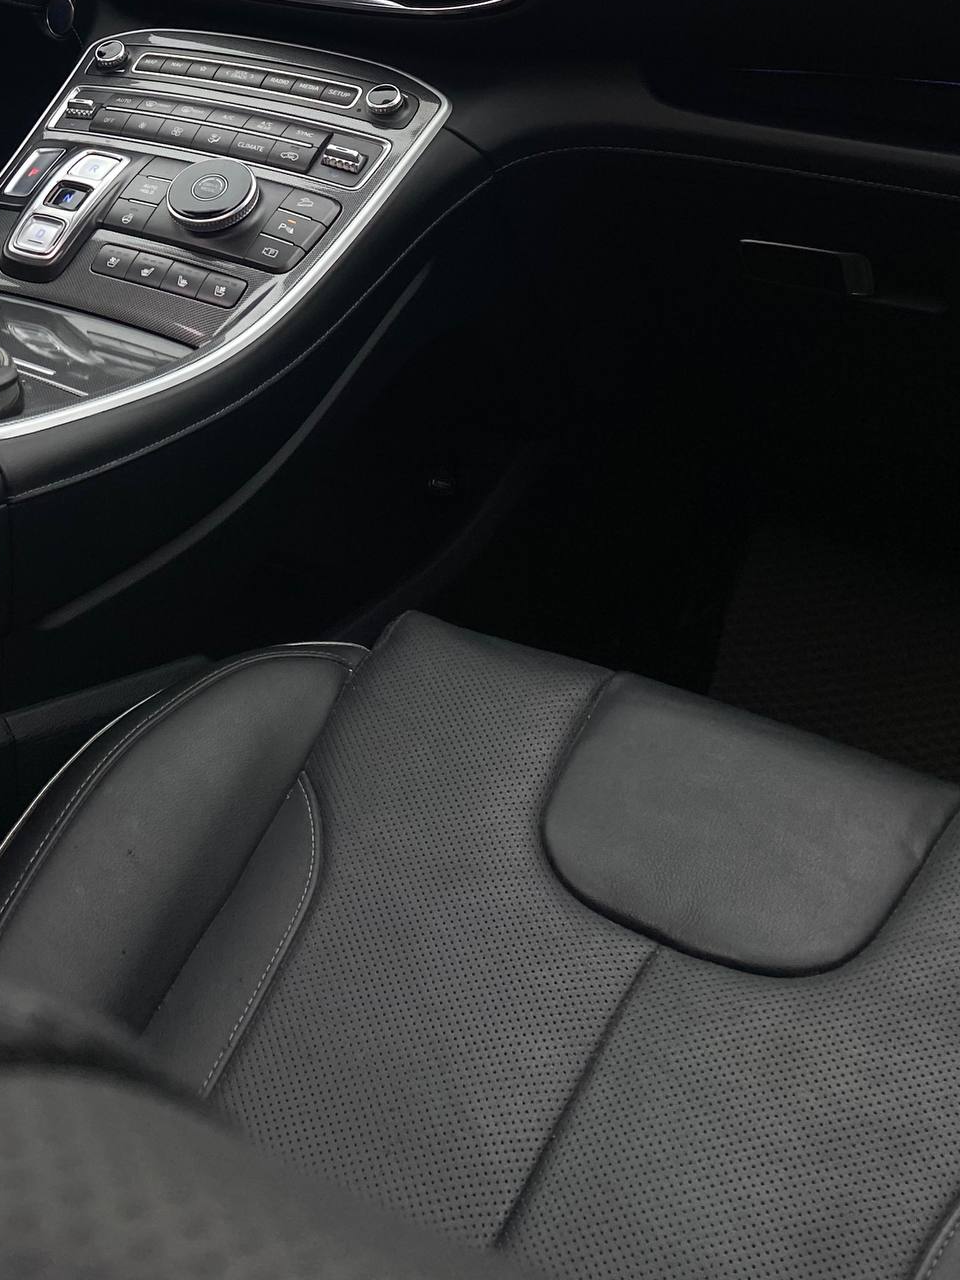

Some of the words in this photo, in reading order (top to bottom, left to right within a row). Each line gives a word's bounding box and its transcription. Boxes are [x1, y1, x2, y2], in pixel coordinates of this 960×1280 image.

[270, 77, 290, 86] RADIO
[299, 82, 320, 92] MEDIA
[327, 88, 352, 98] SETUP
[295, 129, 315, 138] SYNC
[237, 141, 265, 153] CLIMATE
[27, 167, 40, 177] P
[62, 193, 74, 203] N
